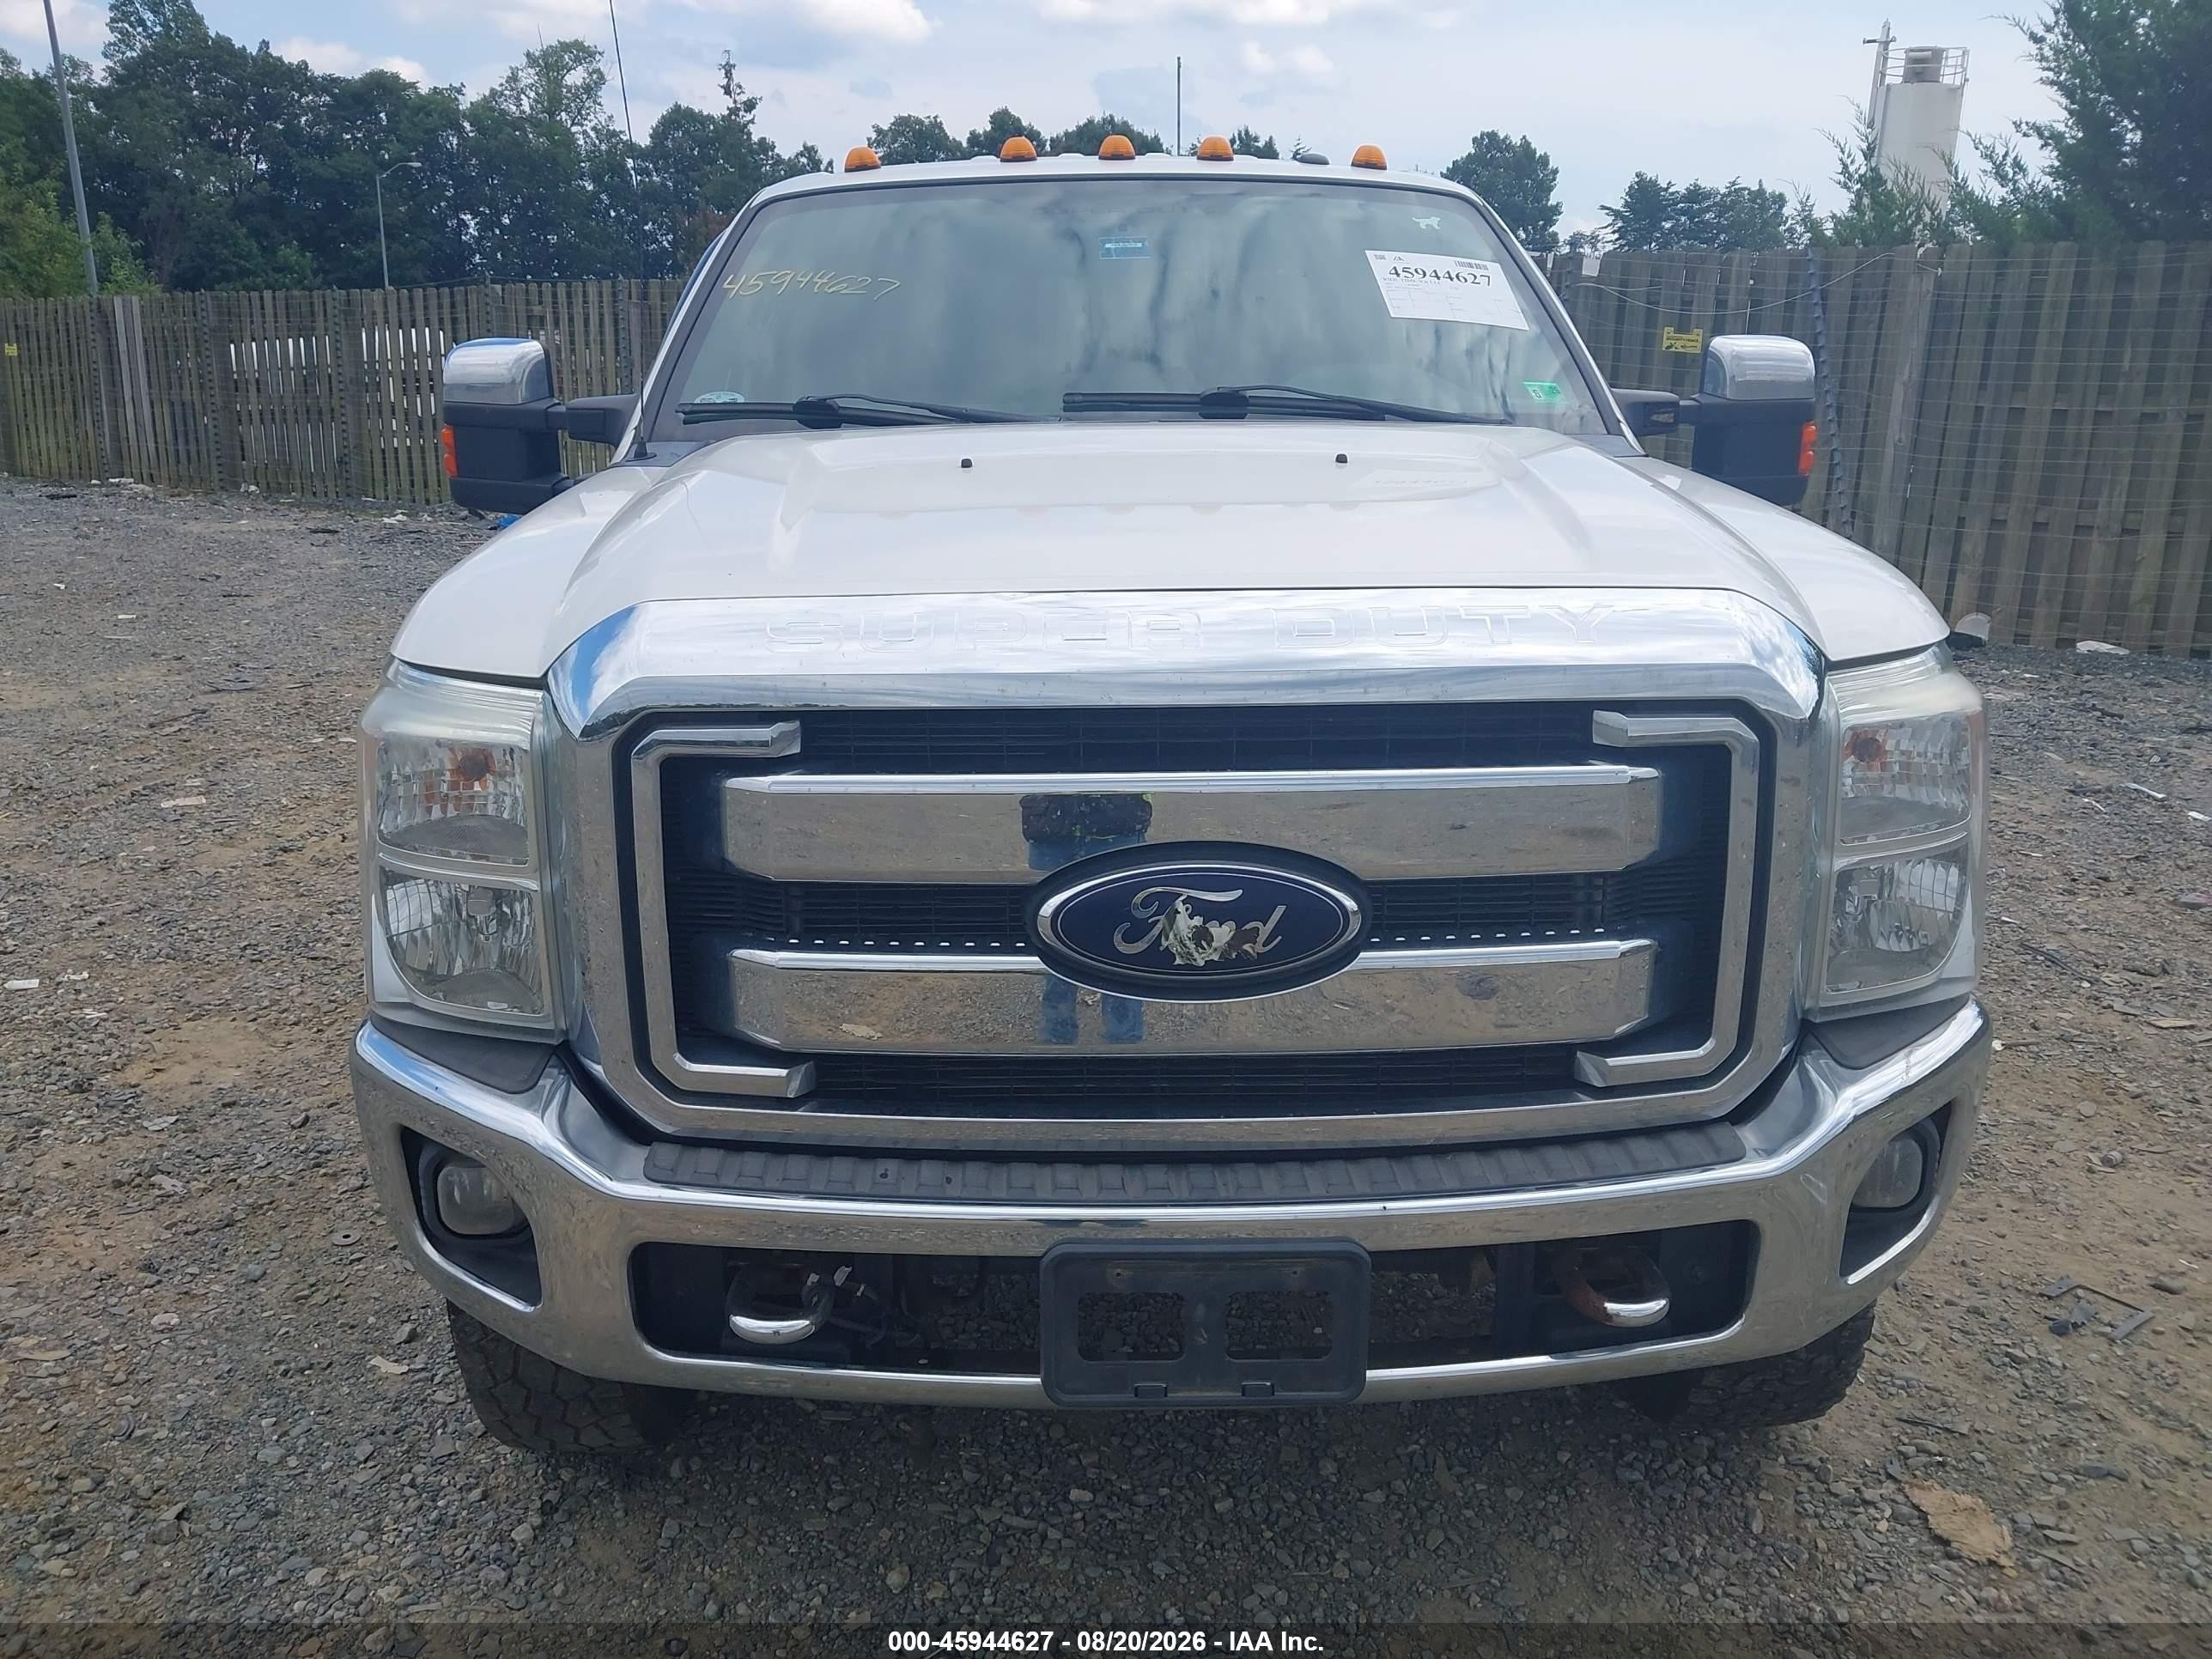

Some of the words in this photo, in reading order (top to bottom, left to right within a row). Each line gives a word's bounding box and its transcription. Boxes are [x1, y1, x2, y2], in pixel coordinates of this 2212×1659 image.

[721, 270, 901, 301] 45944627
[1389, 265, 1491, 287] 45944627
[766, 610, 1201, 654] SUPER
[1271, 604, 1614, 648] DUTY
[1113, 886, 1287, 955] Fd
